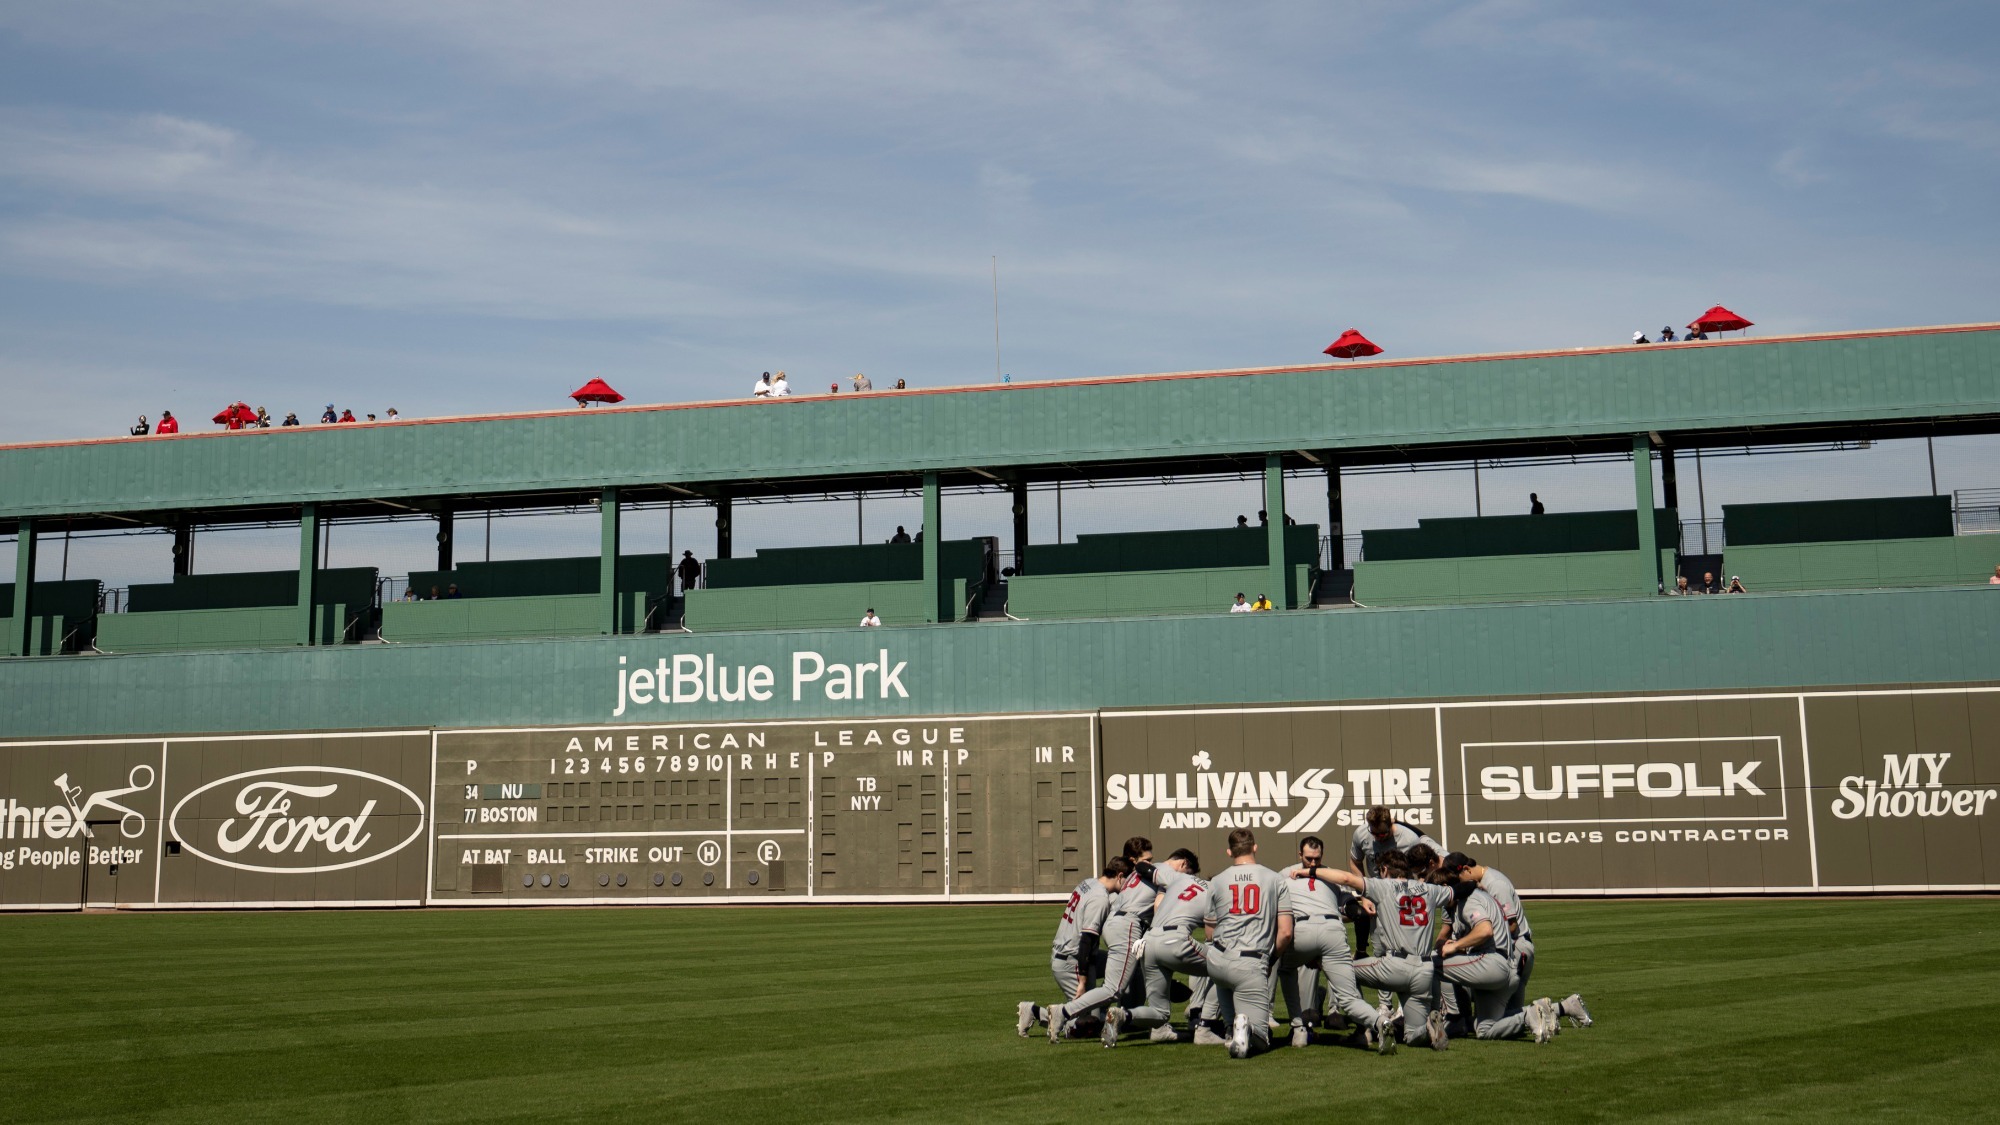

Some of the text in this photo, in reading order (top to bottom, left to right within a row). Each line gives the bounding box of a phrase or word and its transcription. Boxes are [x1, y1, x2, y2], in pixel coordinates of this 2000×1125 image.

[613, 648, 910, 717] jetBlue Park
[565, 727, 965, 753] AMERICAN LEAGUE
[550, 754, 724, 775] 1 2 3 4 5 6 7 8 9 10
[741, 752, 800, 770] R H E
[823, 749, 934, 768] P IN R
[957, 745, 1075, 765] P IN R
[467, 759, 478, 775] P
[1880, 752, 1951, 789] MY
[856, 777, 877, 792] TB
[1106, 767, 1432, 811] SULLIVAN TIRE
[1480, 761, 1766, 801] SUFFOLK
[465, 783, 523, 800] 34 NU
[1831, 775, 1998, 820] Shower
[851, 795, 881, 811] NYY
[217, 781, 377, 854] Ford
[464, 806, 538, 824] 77 BOSTON
[1159, 811, 1211, 829] AND
[1216, 811, 1282, 829] AUTO
[1465, 828, 1790, 845] AMERICA'S CONTRACTOR
[18, 846, 81, 870] People
[88, 845, 144, 865] Better
[461, 846, 715, 865] AT BAT BALL STRIKE OUT H
[1234, 873, 1254, 882] LANE
[1178, 884, 1204, 902] 5
[1229, 883, 1260, 915] 10
[1399, 895, 1428, 927] 23
